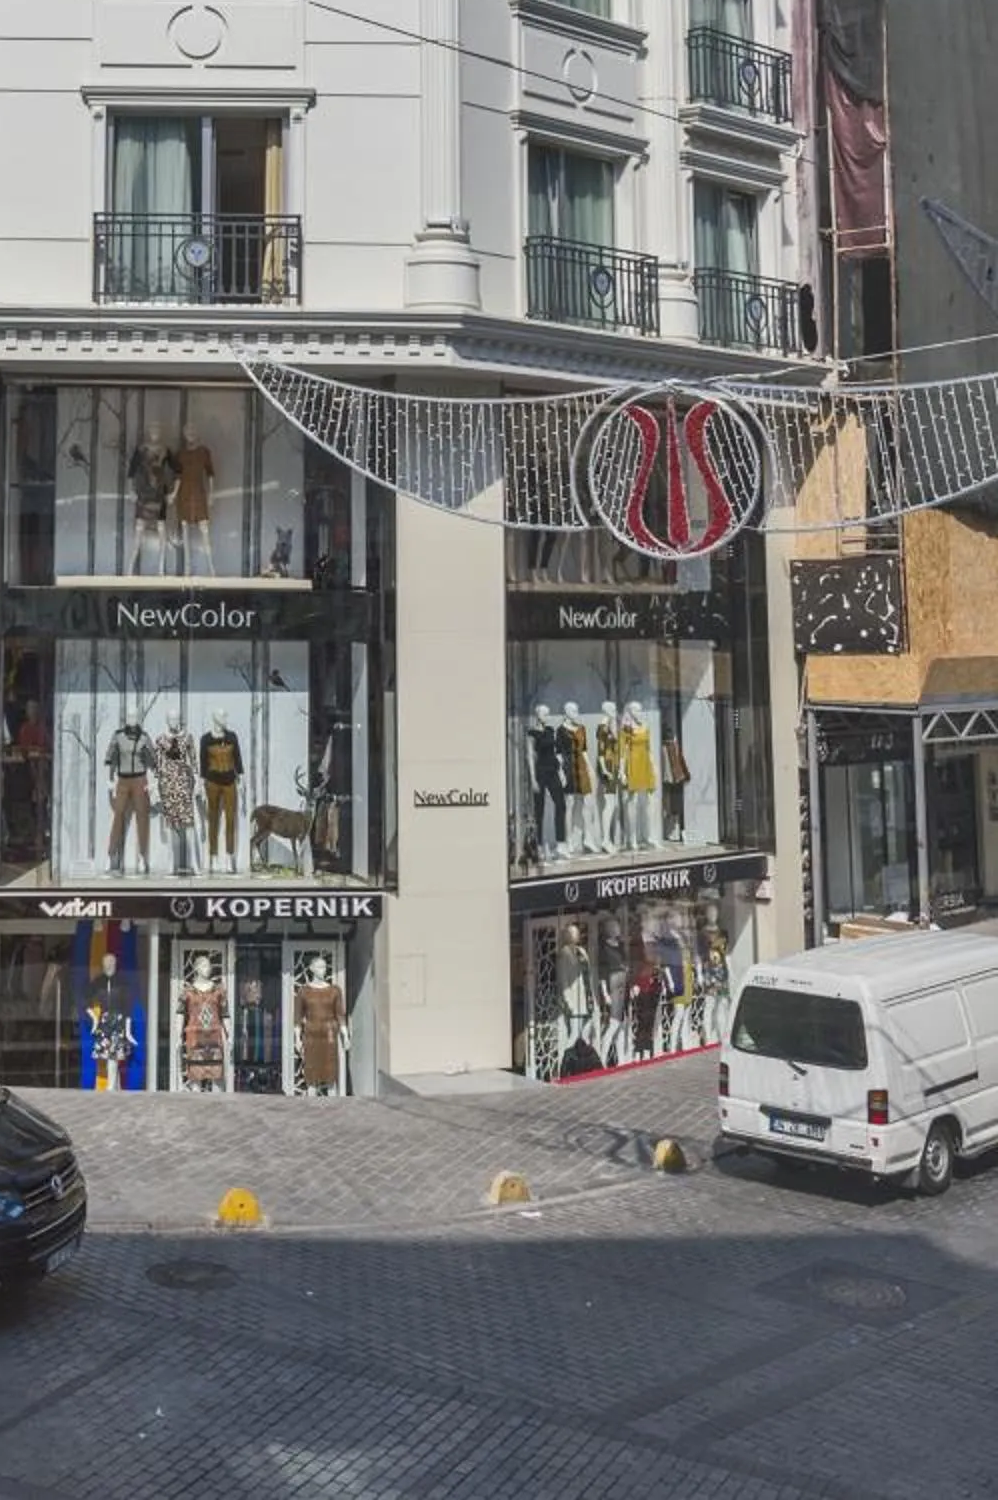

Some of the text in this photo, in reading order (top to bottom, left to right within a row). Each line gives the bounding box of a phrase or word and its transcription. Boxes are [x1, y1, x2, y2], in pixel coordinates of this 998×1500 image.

[117, 601, 256, 628] NewColor
[559, 605, 638, 629] NewColor
[414, 788, 490, 807] NewColor
